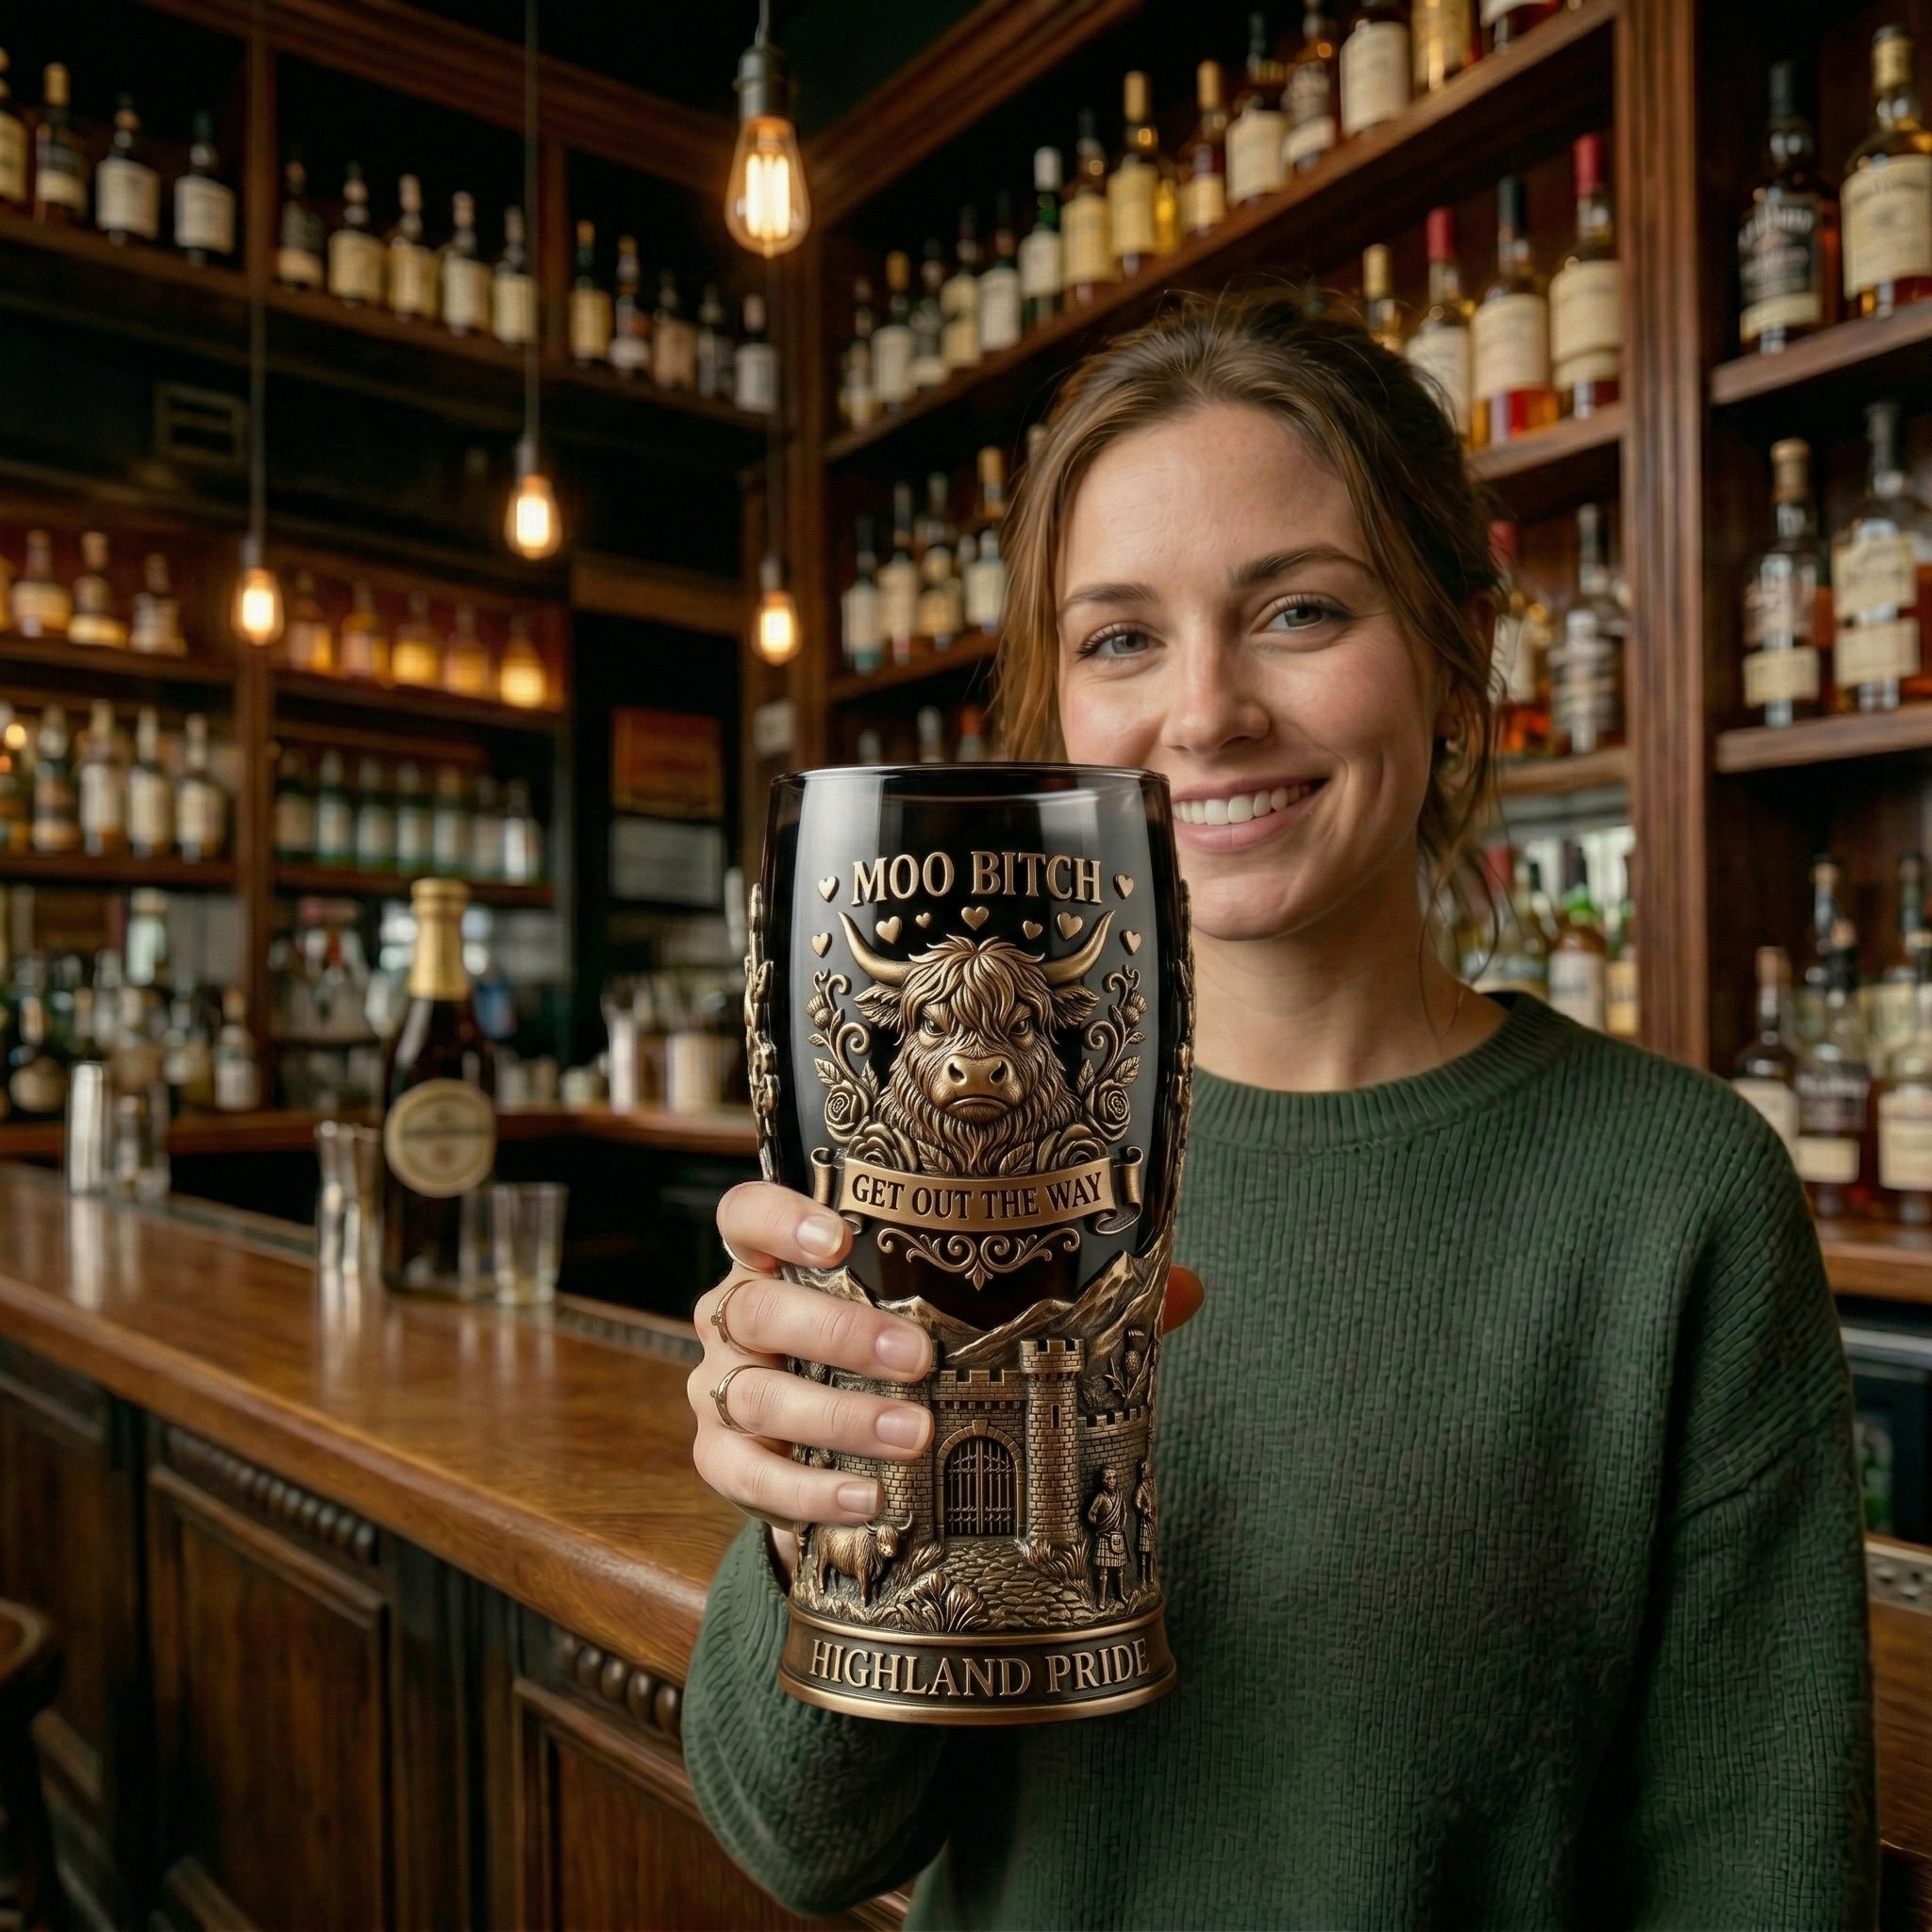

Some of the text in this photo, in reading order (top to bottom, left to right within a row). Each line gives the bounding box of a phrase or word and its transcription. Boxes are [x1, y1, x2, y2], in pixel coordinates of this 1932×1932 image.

[851, 850, 1103, 906] MOO BITCH
[852, 1172, 1103, 1220] GET OUT THE WAY
[808, 1637, 1151, 1697] HIGHLAND PRIDE
